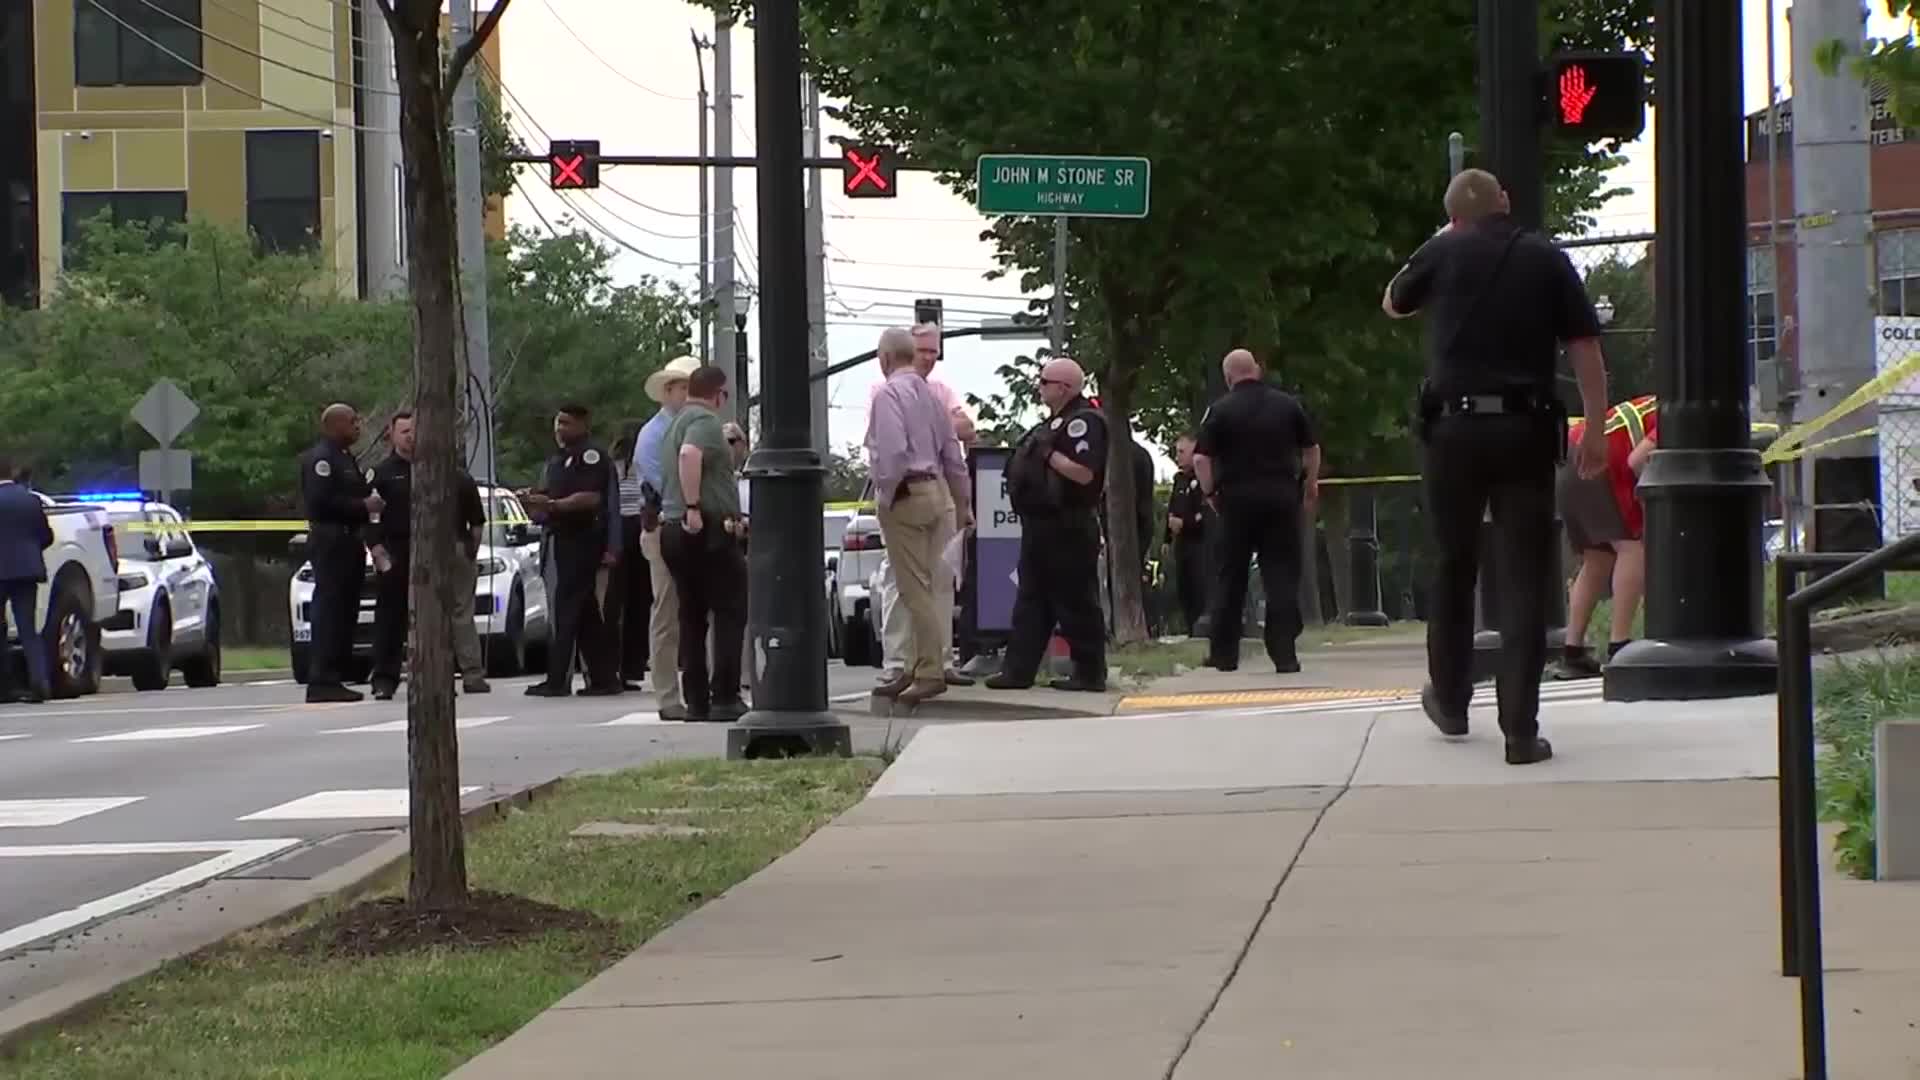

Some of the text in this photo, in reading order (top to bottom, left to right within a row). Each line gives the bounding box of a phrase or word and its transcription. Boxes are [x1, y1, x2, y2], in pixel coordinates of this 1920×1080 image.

[992, 167, 1134, 186] JOHN M STONE SR
[1037, 191, 1084, 204] HIGHWAY
